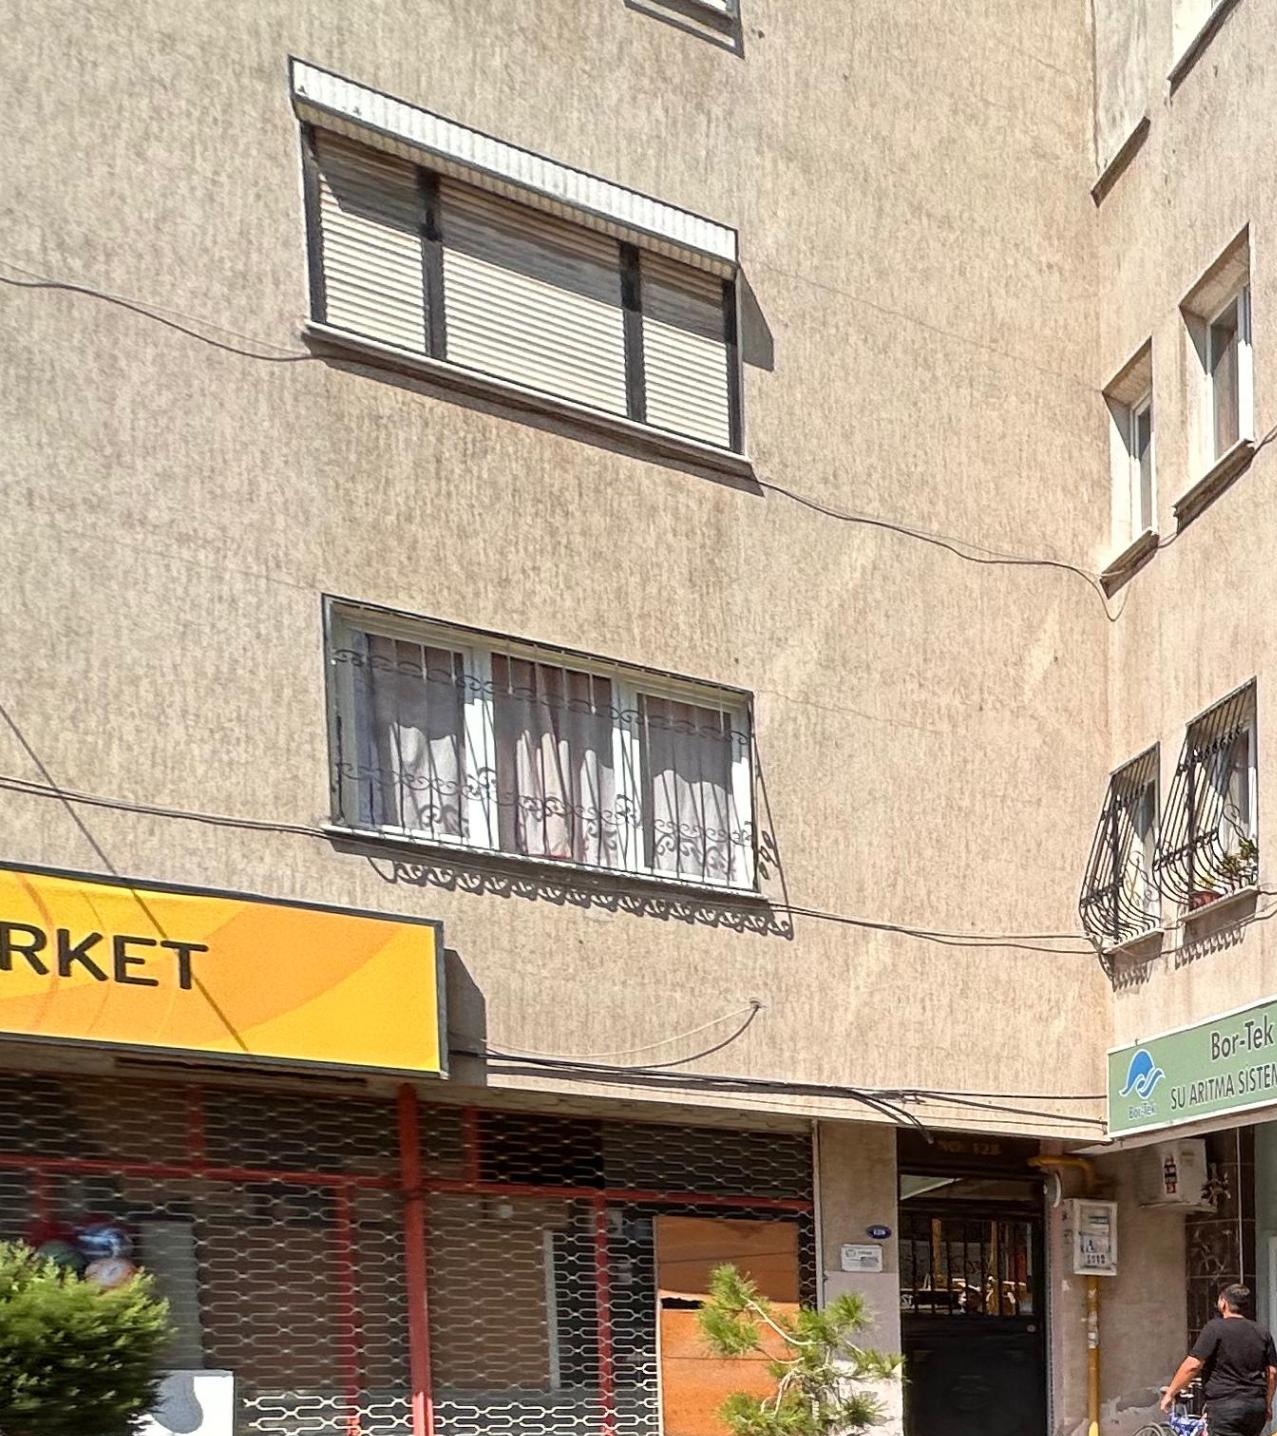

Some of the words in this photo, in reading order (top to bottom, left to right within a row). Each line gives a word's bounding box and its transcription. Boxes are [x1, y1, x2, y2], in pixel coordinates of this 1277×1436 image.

[0, 921, 209, 990] RKET
[1212, 1015, 1274, 1060] Bor-Tek
[1171, 1087, 1186, 1110] SU
[1190, 1074, 1234, 1105] ARITMA
